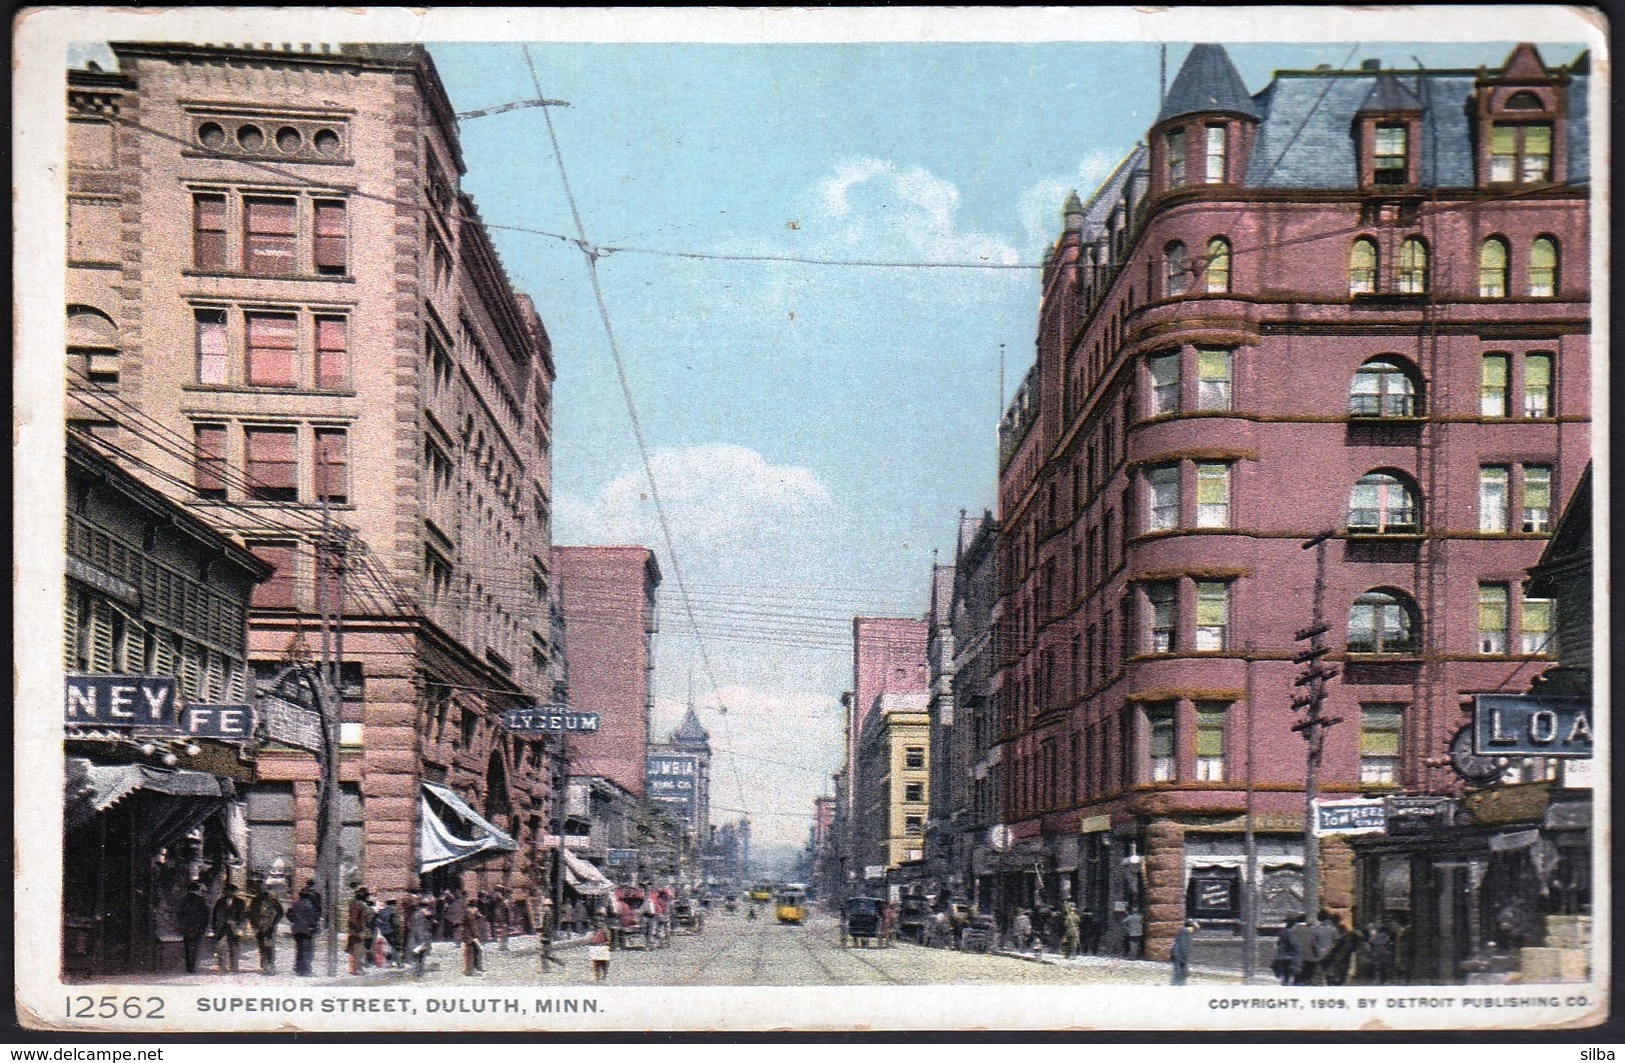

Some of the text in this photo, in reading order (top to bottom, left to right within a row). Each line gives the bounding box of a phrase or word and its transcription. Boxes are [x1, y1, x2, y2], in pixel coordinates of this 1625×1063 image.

[69, 684, 169, 719] NEY
[190, 709, 243, 733] FE
[1491, 709, 1591, 743] LOA
[66, 995, 165, 1020] 12562
[196, 997, 604, 1015] SUPERIOR STREET, DULUTH, MINN.
[1208, 998, 1306, 1011] COPYRIGHT,
[1357, 998, 1378, 1009] BY
[1387, 997, 1456, 1008] DETROIT
[1461, 997, 1560, 1008] PUBLISHING
[1566, 996, 1592, 1007] CO.
